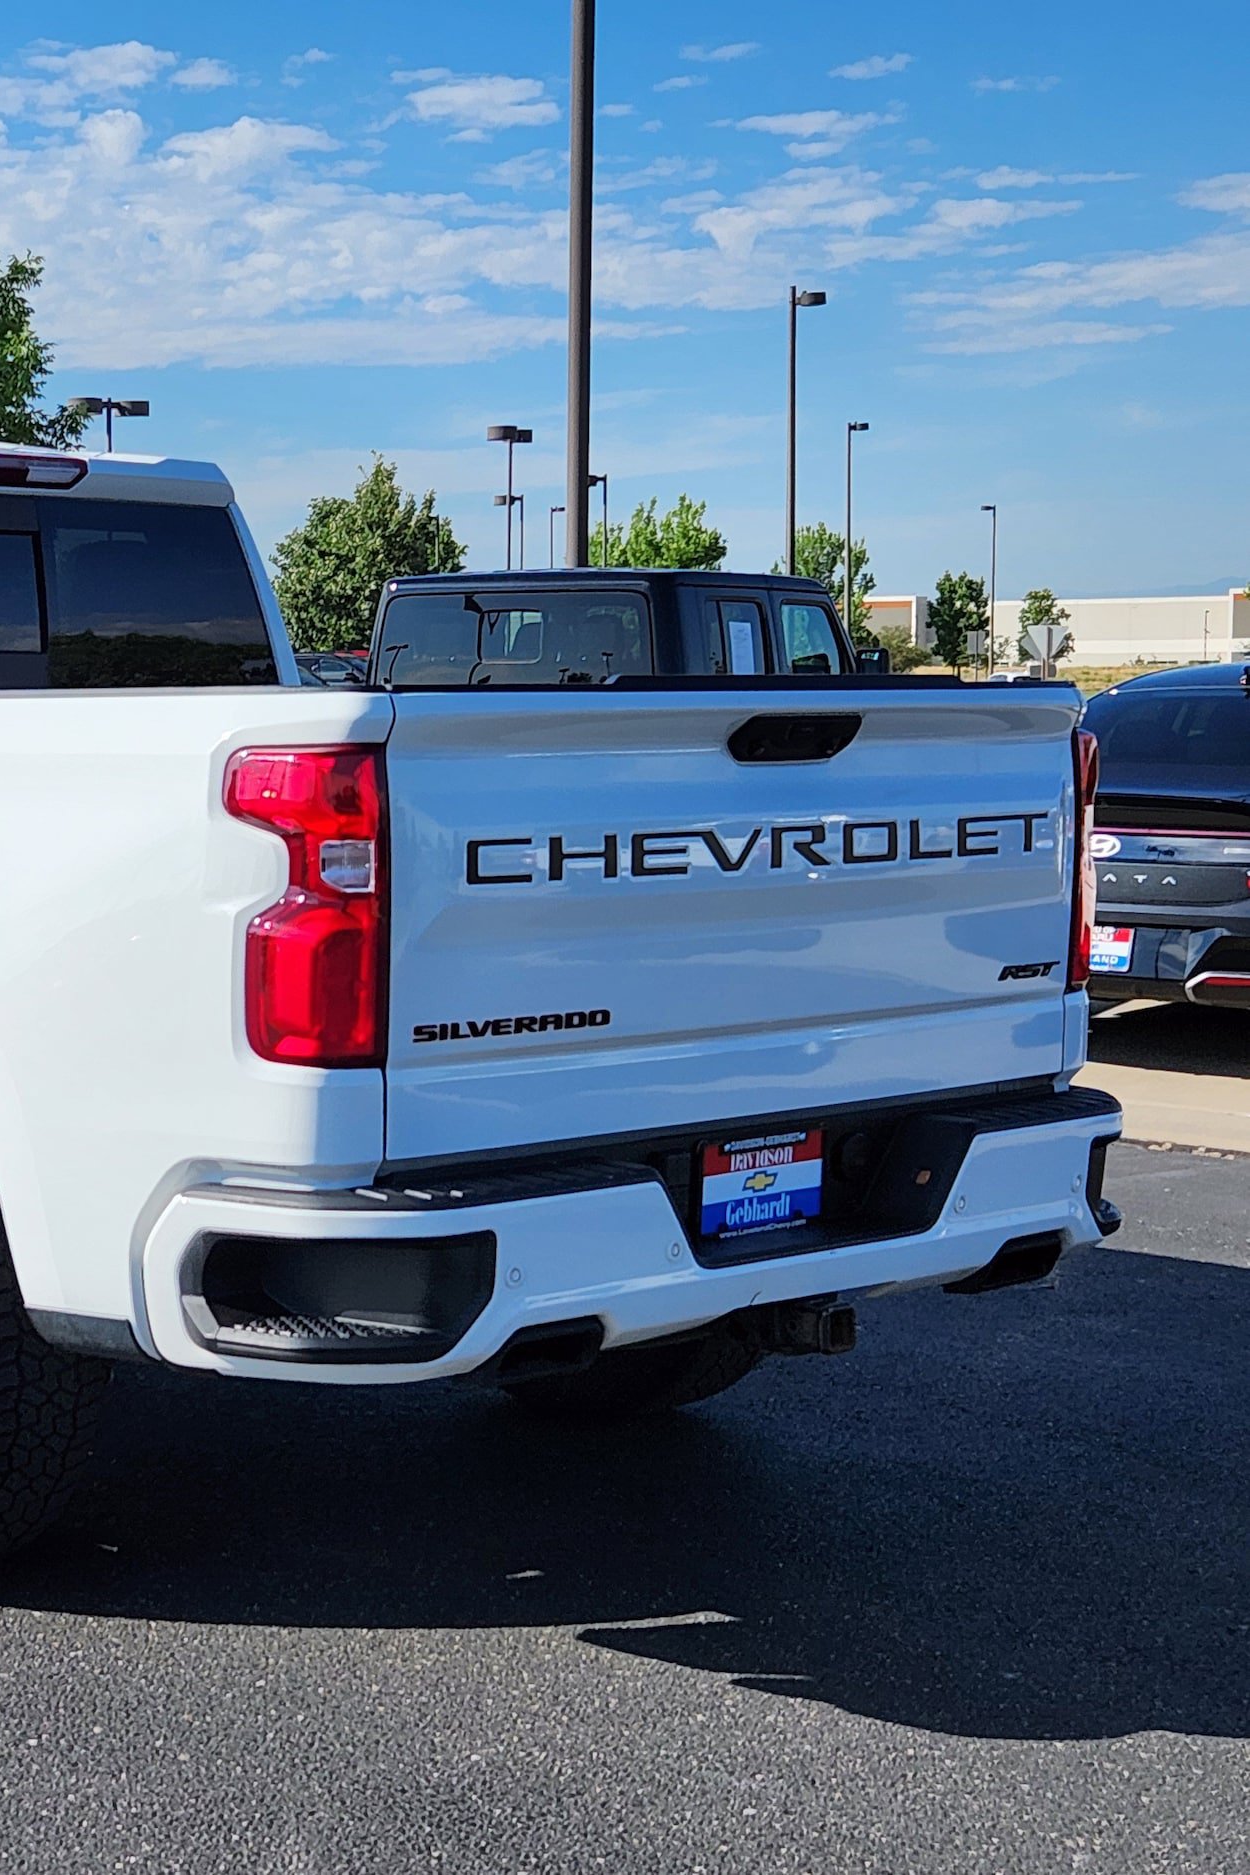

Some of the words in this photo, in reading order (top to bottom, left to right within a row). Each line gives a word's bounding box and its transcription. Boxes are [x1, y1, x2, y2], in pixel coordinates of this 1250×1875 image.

[465, 812, 1049, 885] CHEVROLET
[997, 960, 1061, 981] RST
[412, 1009, 611, 1043] SILVERADO
